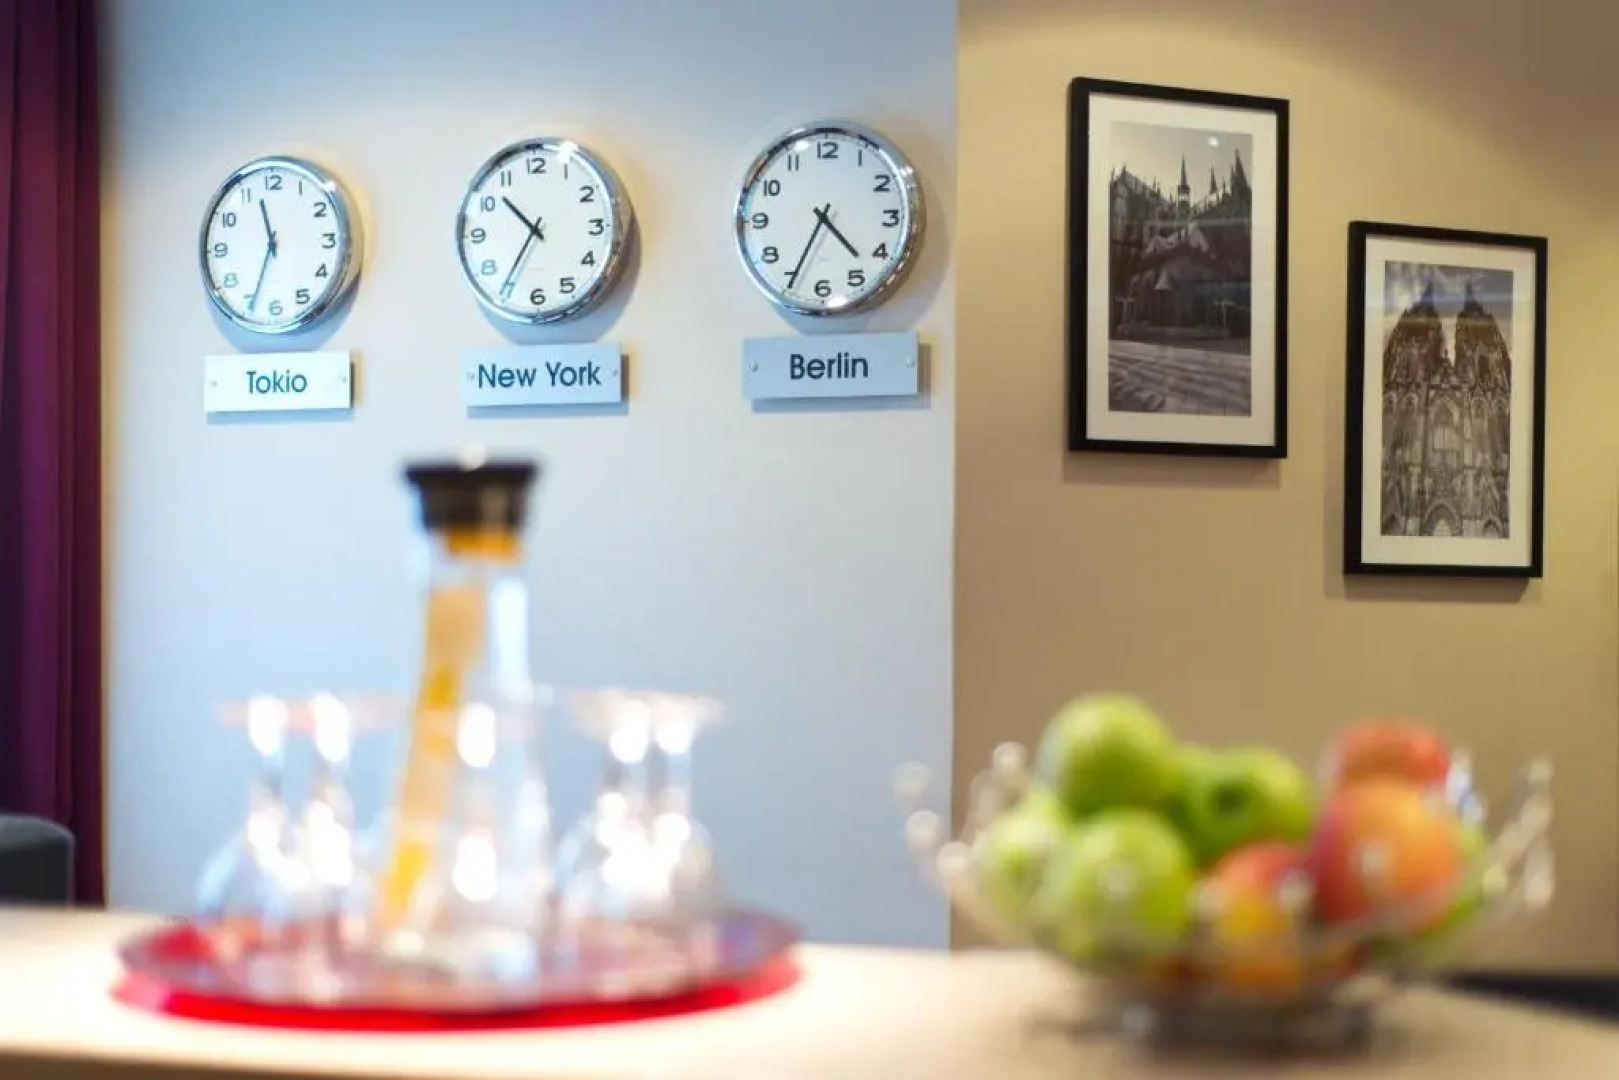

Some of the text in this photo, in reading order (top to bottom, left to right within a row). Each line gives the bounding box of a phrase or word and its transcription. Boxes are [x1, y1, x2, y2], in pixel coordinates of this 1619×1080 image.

[817, 142, 839, 159] 12
[526, 158, 546, 174] 12
[788, 155, 799, 171] 11
[265, 175, 282, 190] 12
[501, 171, 511, 186] 11
[873, 175, 890, 191] 2
[242, 188, 250, 203] 11
[579, 187, 594, 202] 2
[764, 180, 780, 196] 10
[314, 202, 327, 217] 2
[481, 196, 495, 212] 10
[223, 213, 236, 228] 10
[588, 218, 604, 235] 3
[753, 213, 768, 229] 9
[882, 210, 899, 227] 3
[322, 233, 336, 248] 3
[471, 228, 486, 243] 9
[215, 243, 228, 258] 9
[581, 251, 595, 266] 4
[762, 247, 779, 263] 8
[872, 243, 888, 259] 4
[315, 264, 328, 278] 4
[481, 260, 497, 275] 8
[224, 273, 238, 288] 8
[560, 278, 575, 293] 5
[848, 270, 865, 286] 5
[296, 289, 310, 304] 5
[814, 280, 831, 297] 6
[530, 289, 545, 305] 6
[269, 301, 283, 315] 6
[790, 352, 869, 380] Berlin
[246, 370, 308, 394] Tokio
[478, 360, 601, 389] New York
